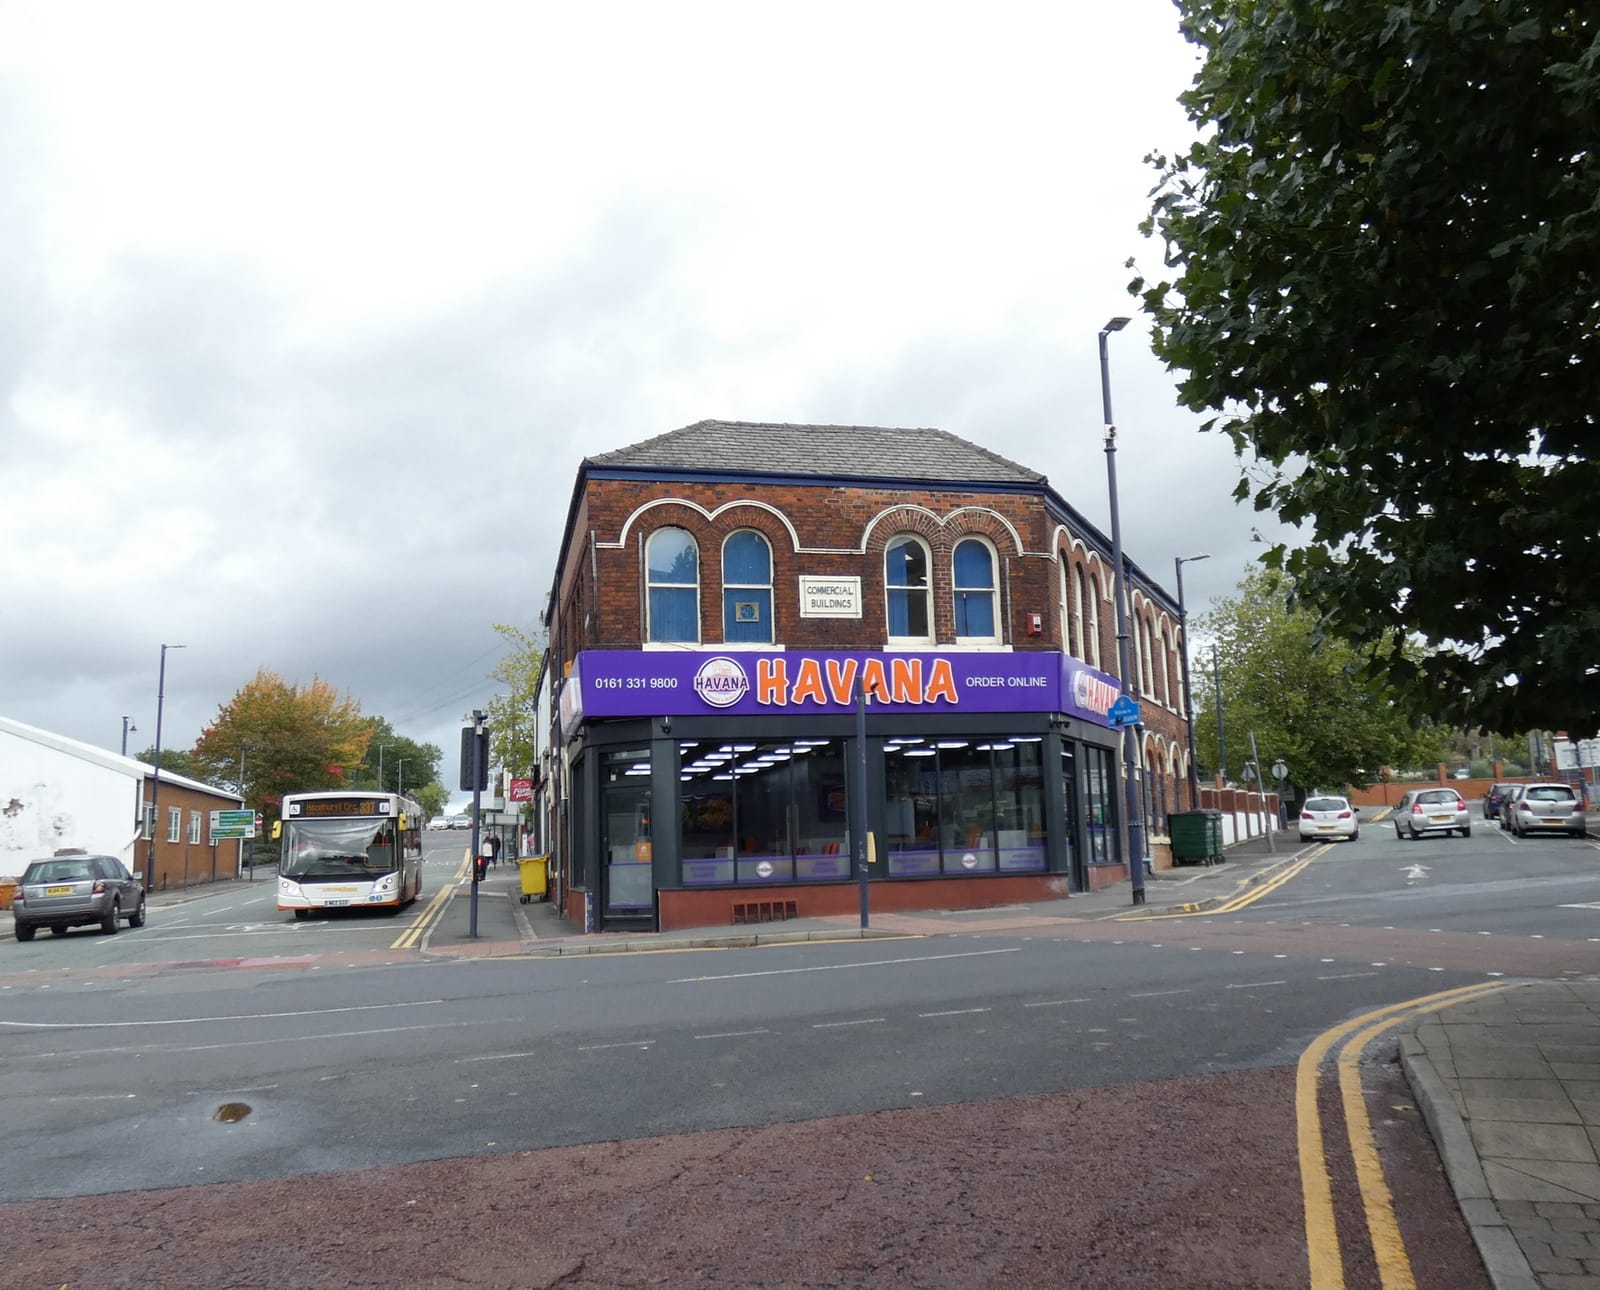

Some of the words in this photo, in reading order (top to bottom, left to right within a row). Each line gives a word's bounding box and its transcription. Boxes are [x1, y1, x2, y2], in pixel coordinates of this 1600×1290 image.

[806, 585, 855, 595] COMMERCIAL
[811, 598, 852, 608] BUILDINGS
[594, 677, 623, 689] 0161
[626, 677, 646, 689] 331
[650, 677, 678, 689] 9800
[695, 677, 749, 690] HAVANA
[757, 657, 960, 706] HAVANA
[965, 676, 1006, 688] ORDER
[1007, 676, 1048, 688] ONLINE
